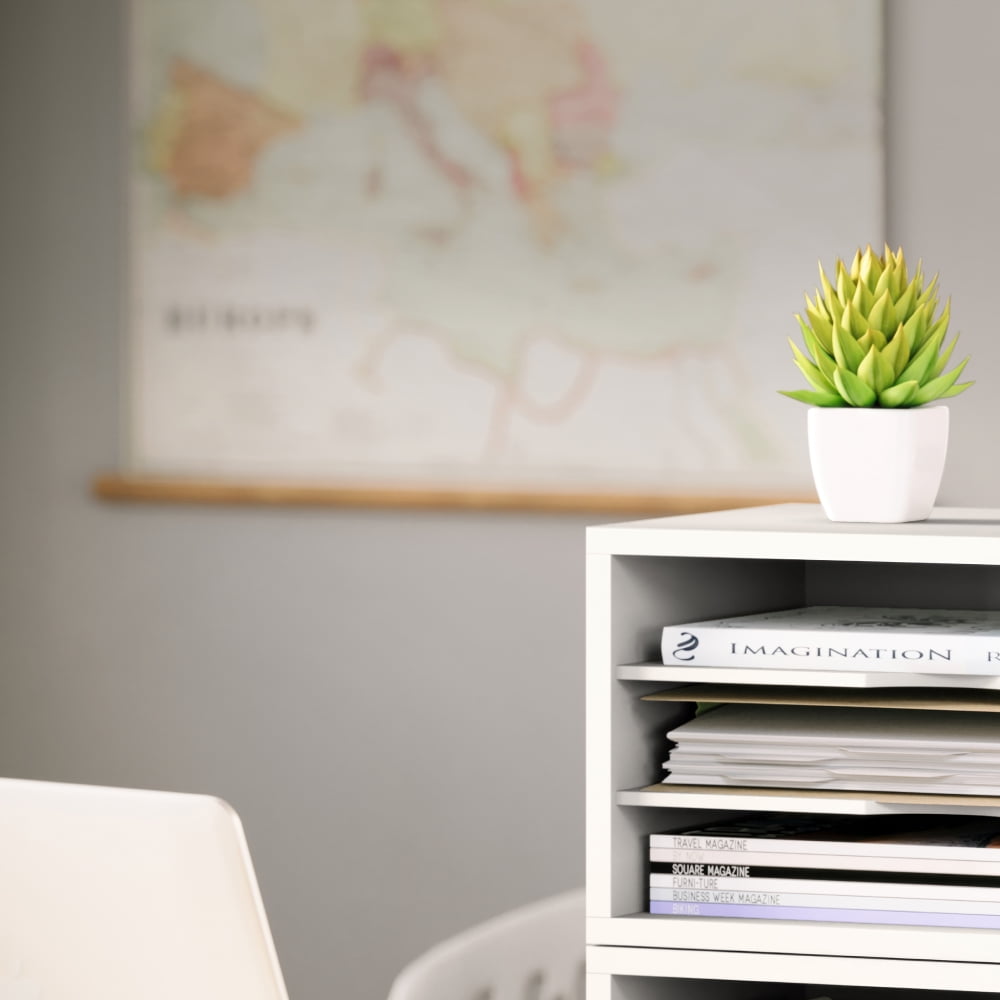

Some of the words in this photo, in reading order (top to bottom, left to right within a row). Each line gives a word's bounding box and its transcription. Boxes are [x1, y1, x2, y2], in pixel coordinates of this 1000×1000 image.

[730, 643, 952, 661] IMAGINATION
[672, 837, 702, 849] TRAVEL
[705, 839, 748, 851] MAGAZINE
[672, 863, 705, 876] SQUARE
[707, 865, 750, 878] MAGAZINE
[672, 890, 710, 902] BUSINESS
[713, 892, 735, 903] WEEK
[738, 894, 780, 905] MAGAZINE
